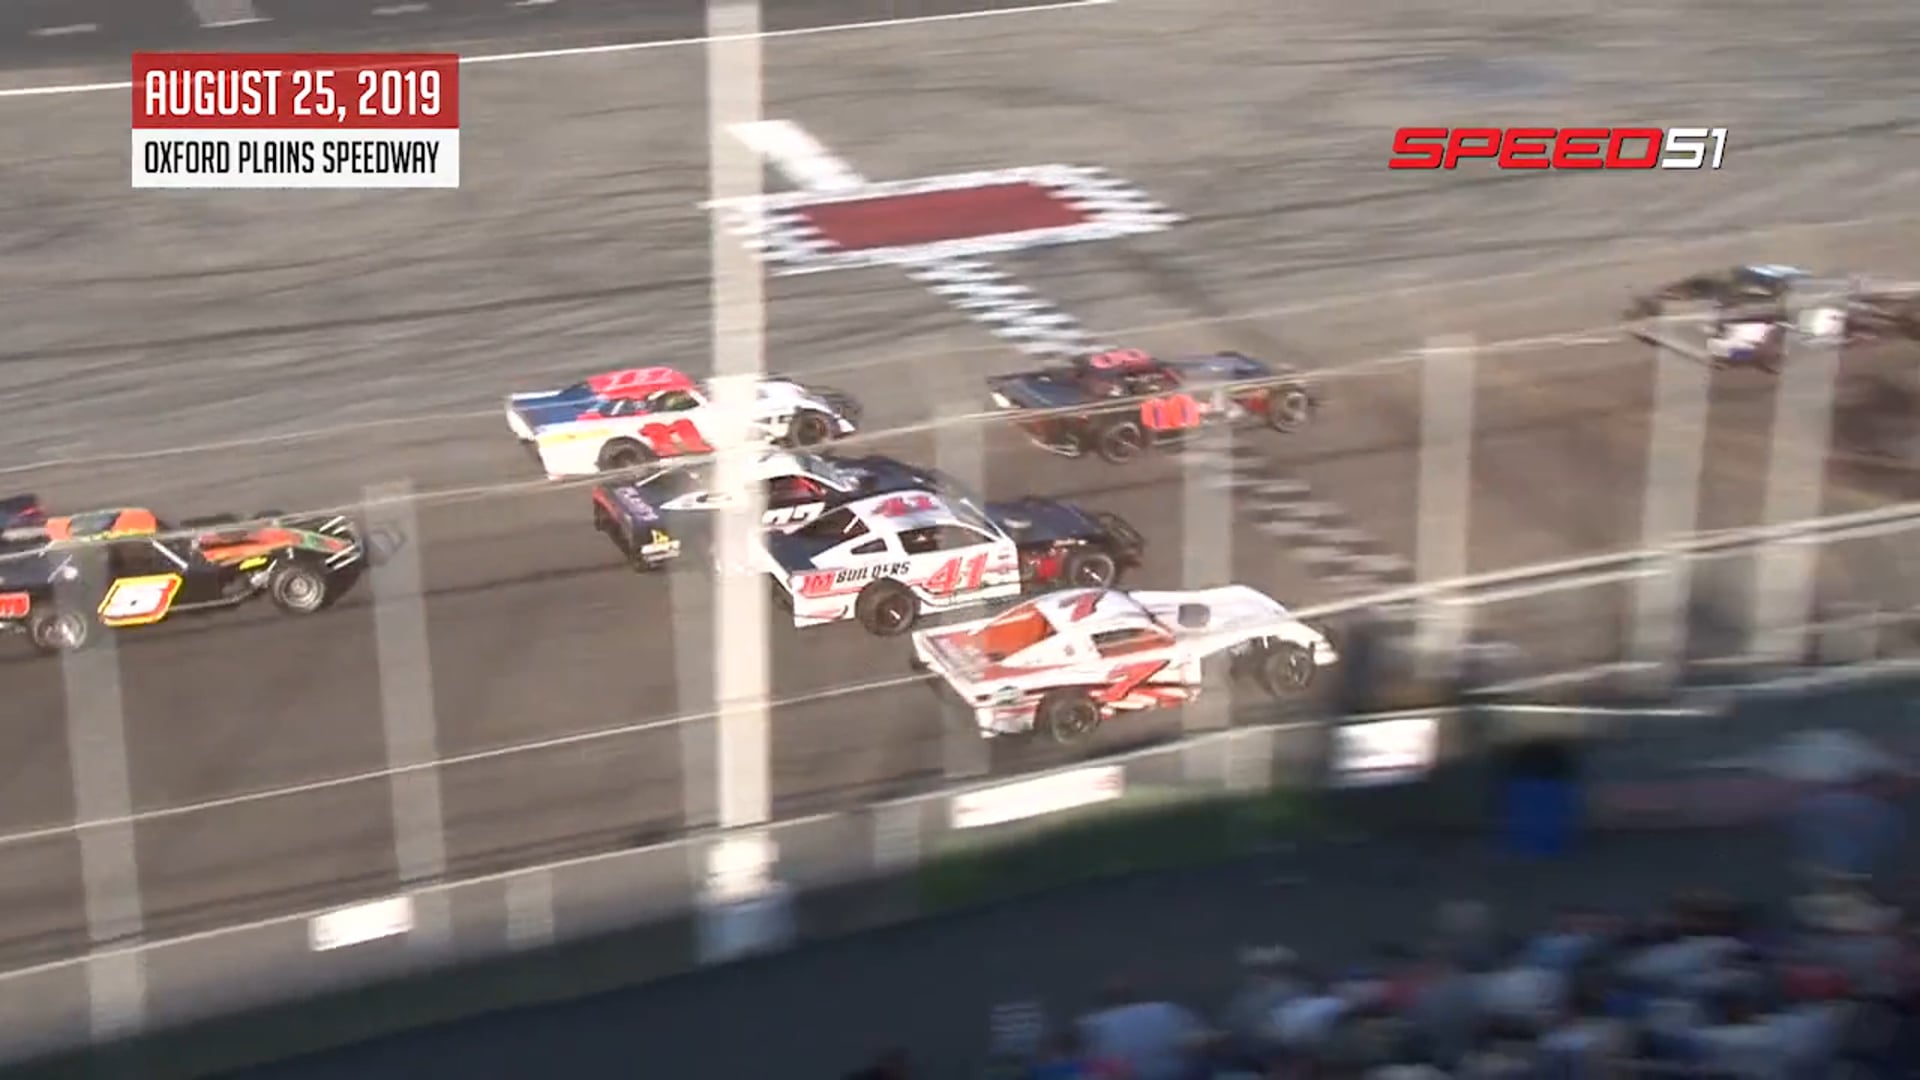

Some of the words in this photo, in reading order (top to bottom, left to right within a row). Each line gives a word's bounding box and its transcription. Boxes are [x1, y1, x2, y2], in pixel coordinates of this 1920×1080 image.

[872, 495, 940, 518] 41
[926, 551, 988, 595] 41
[1058, 591, 1107, 622] 7
[1104, 659, 1170, 701] 7
